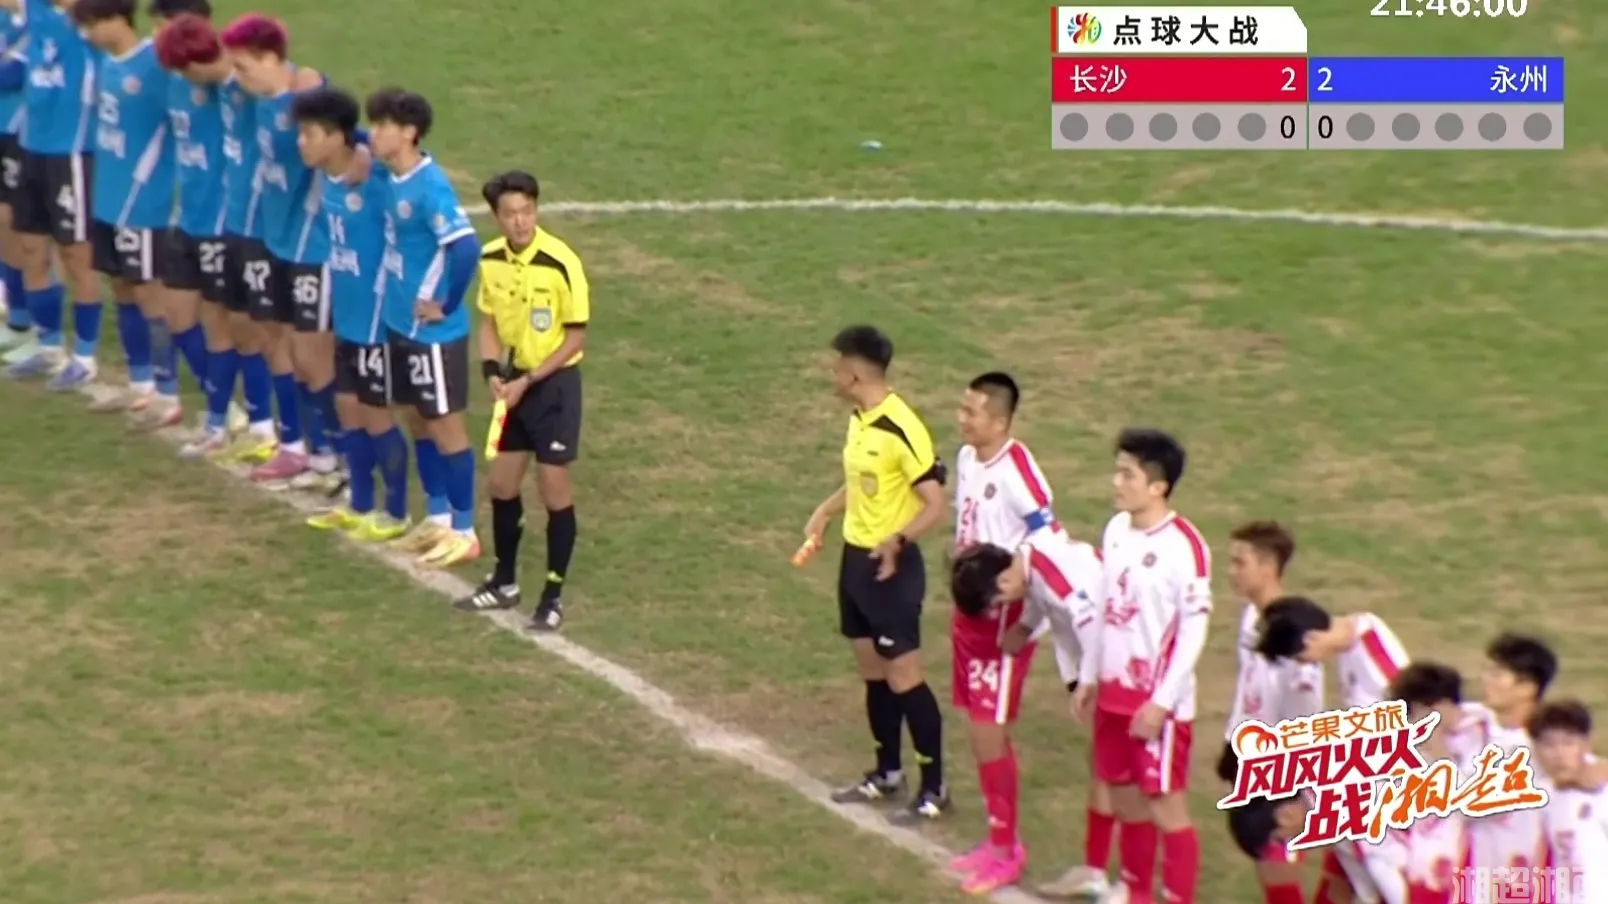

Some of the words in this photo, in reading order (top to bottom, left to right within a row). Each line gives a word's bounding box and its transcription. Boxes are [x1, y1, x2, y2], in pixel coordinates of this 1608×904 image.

[357, 346, 384, 378] 14
[408, 354, 435, 385] 21
[967, 658, 998, 692] 24
